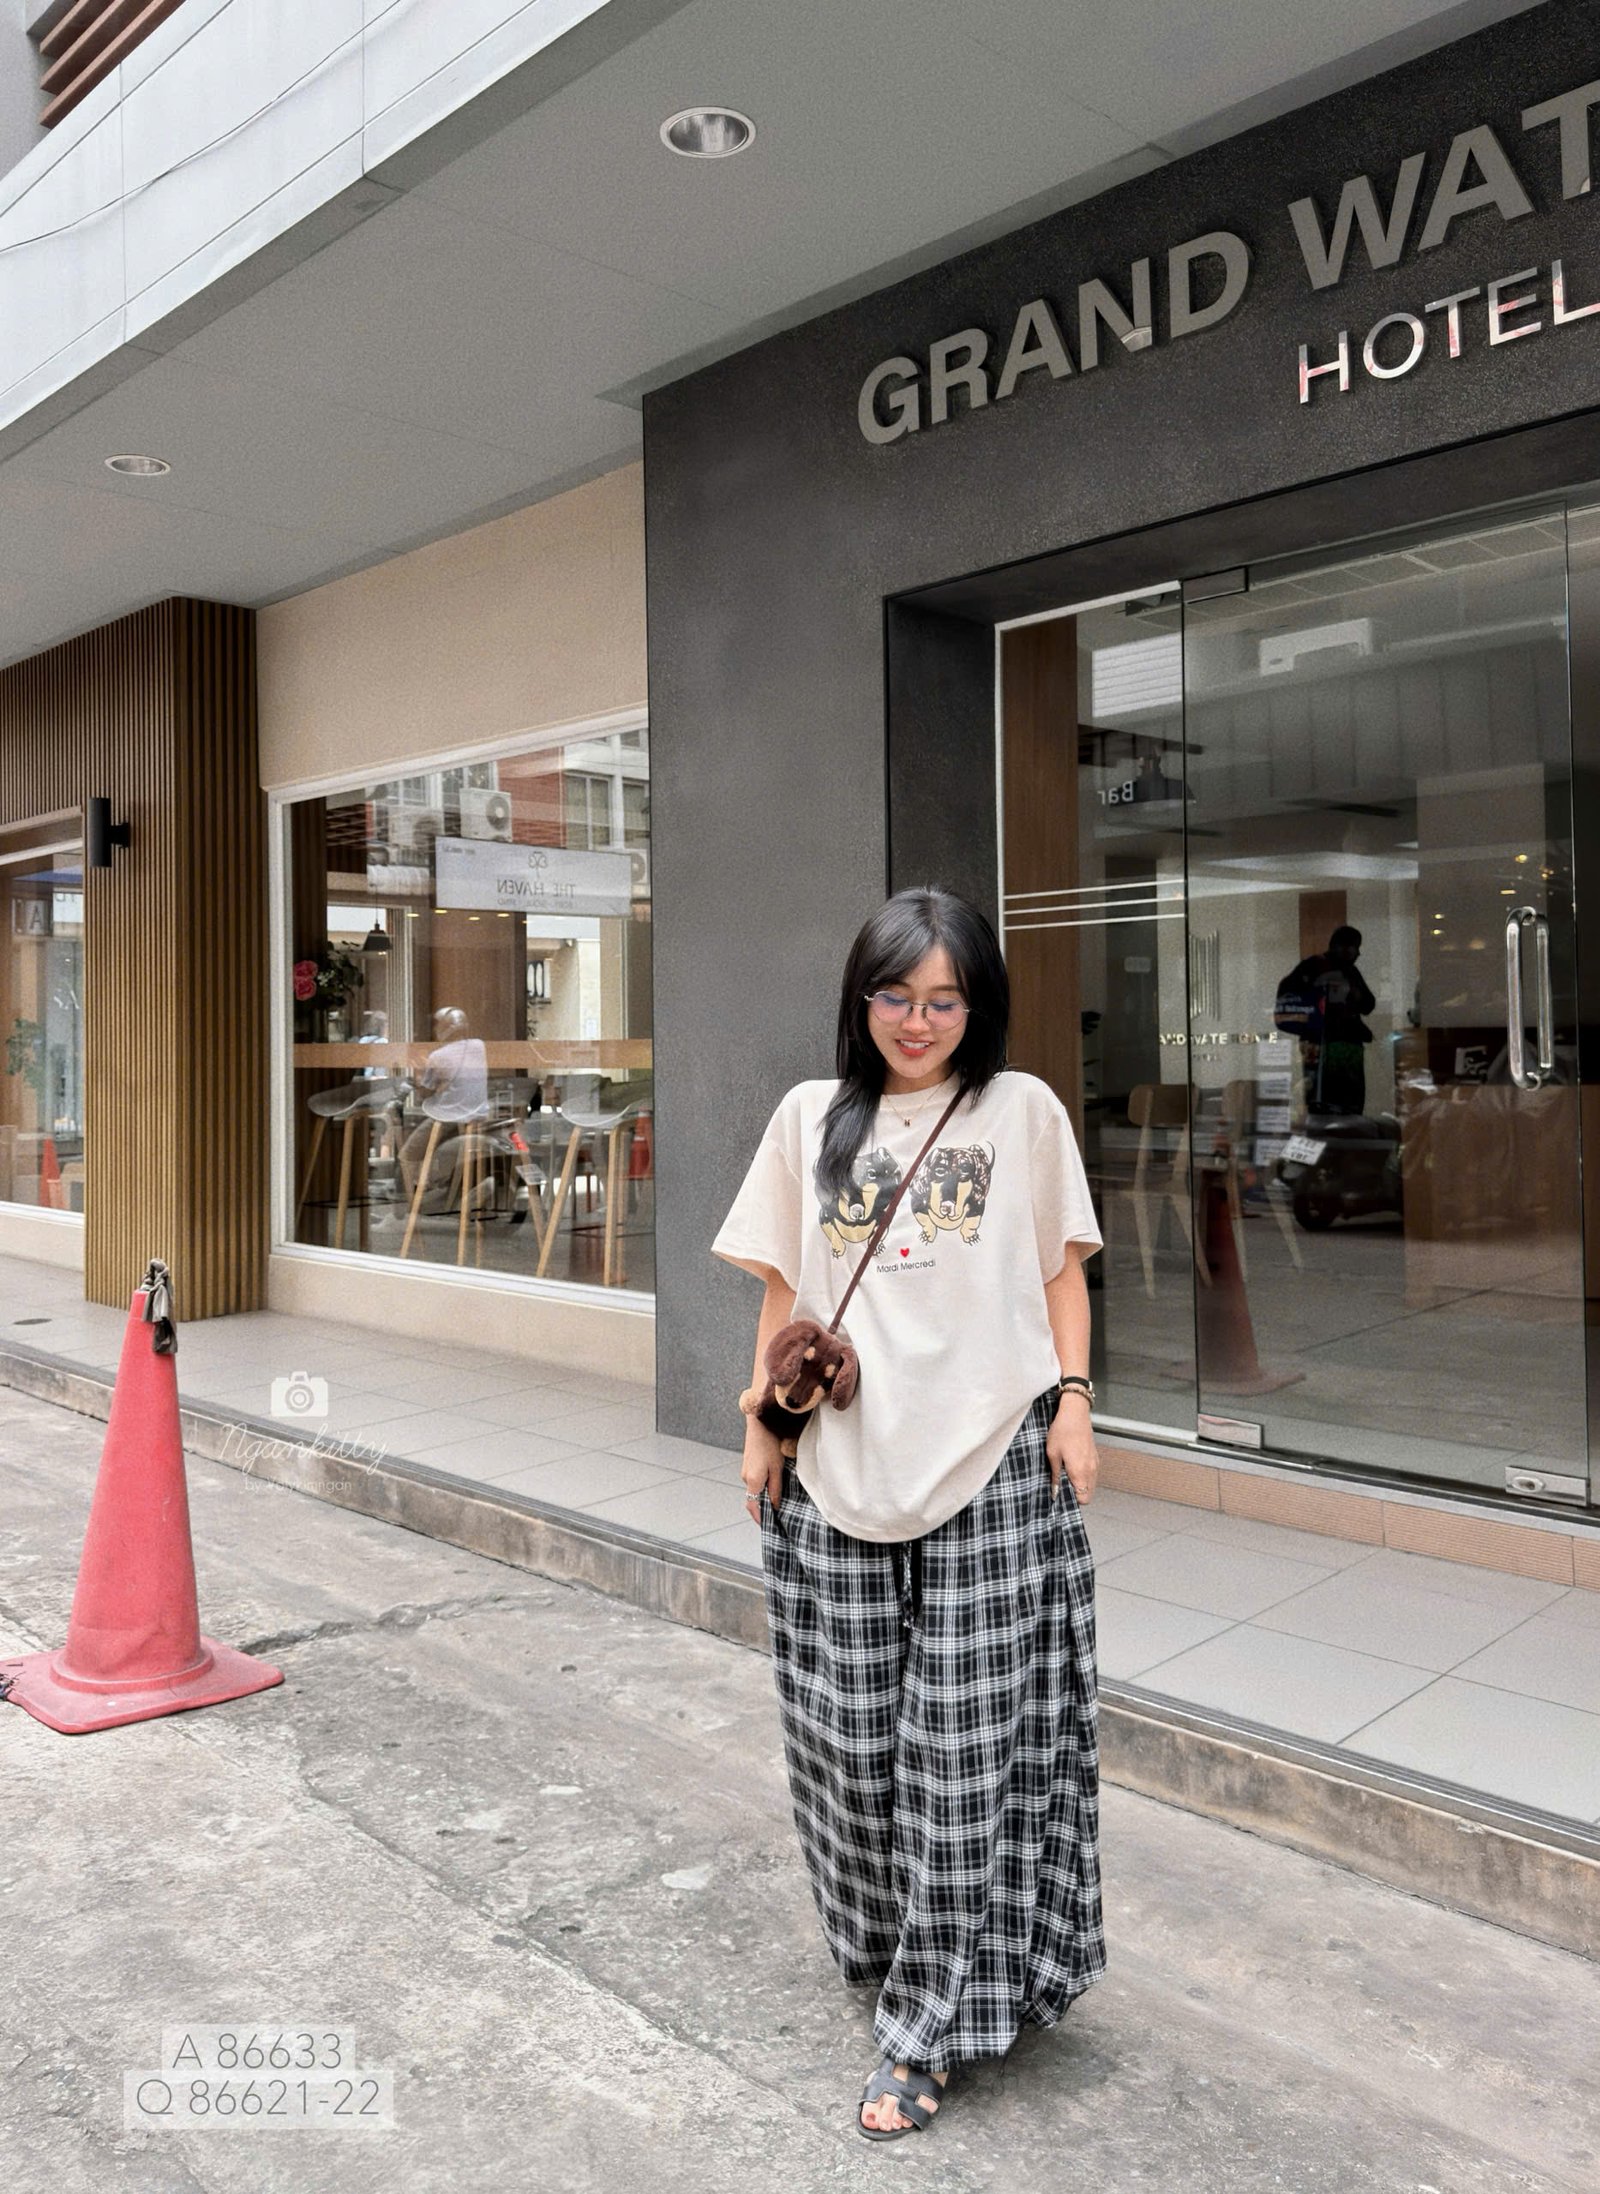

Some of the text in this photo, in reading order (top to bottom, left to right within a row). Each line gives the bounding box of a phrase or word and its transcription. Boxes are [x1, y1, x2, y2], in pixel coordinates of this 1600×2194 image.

[858, 79, 1600, 444] GRAND WAT
[1299, 259, 1600, 404] HOTEL
[876, 1259, 936, 1273] Mardi Mercredi
